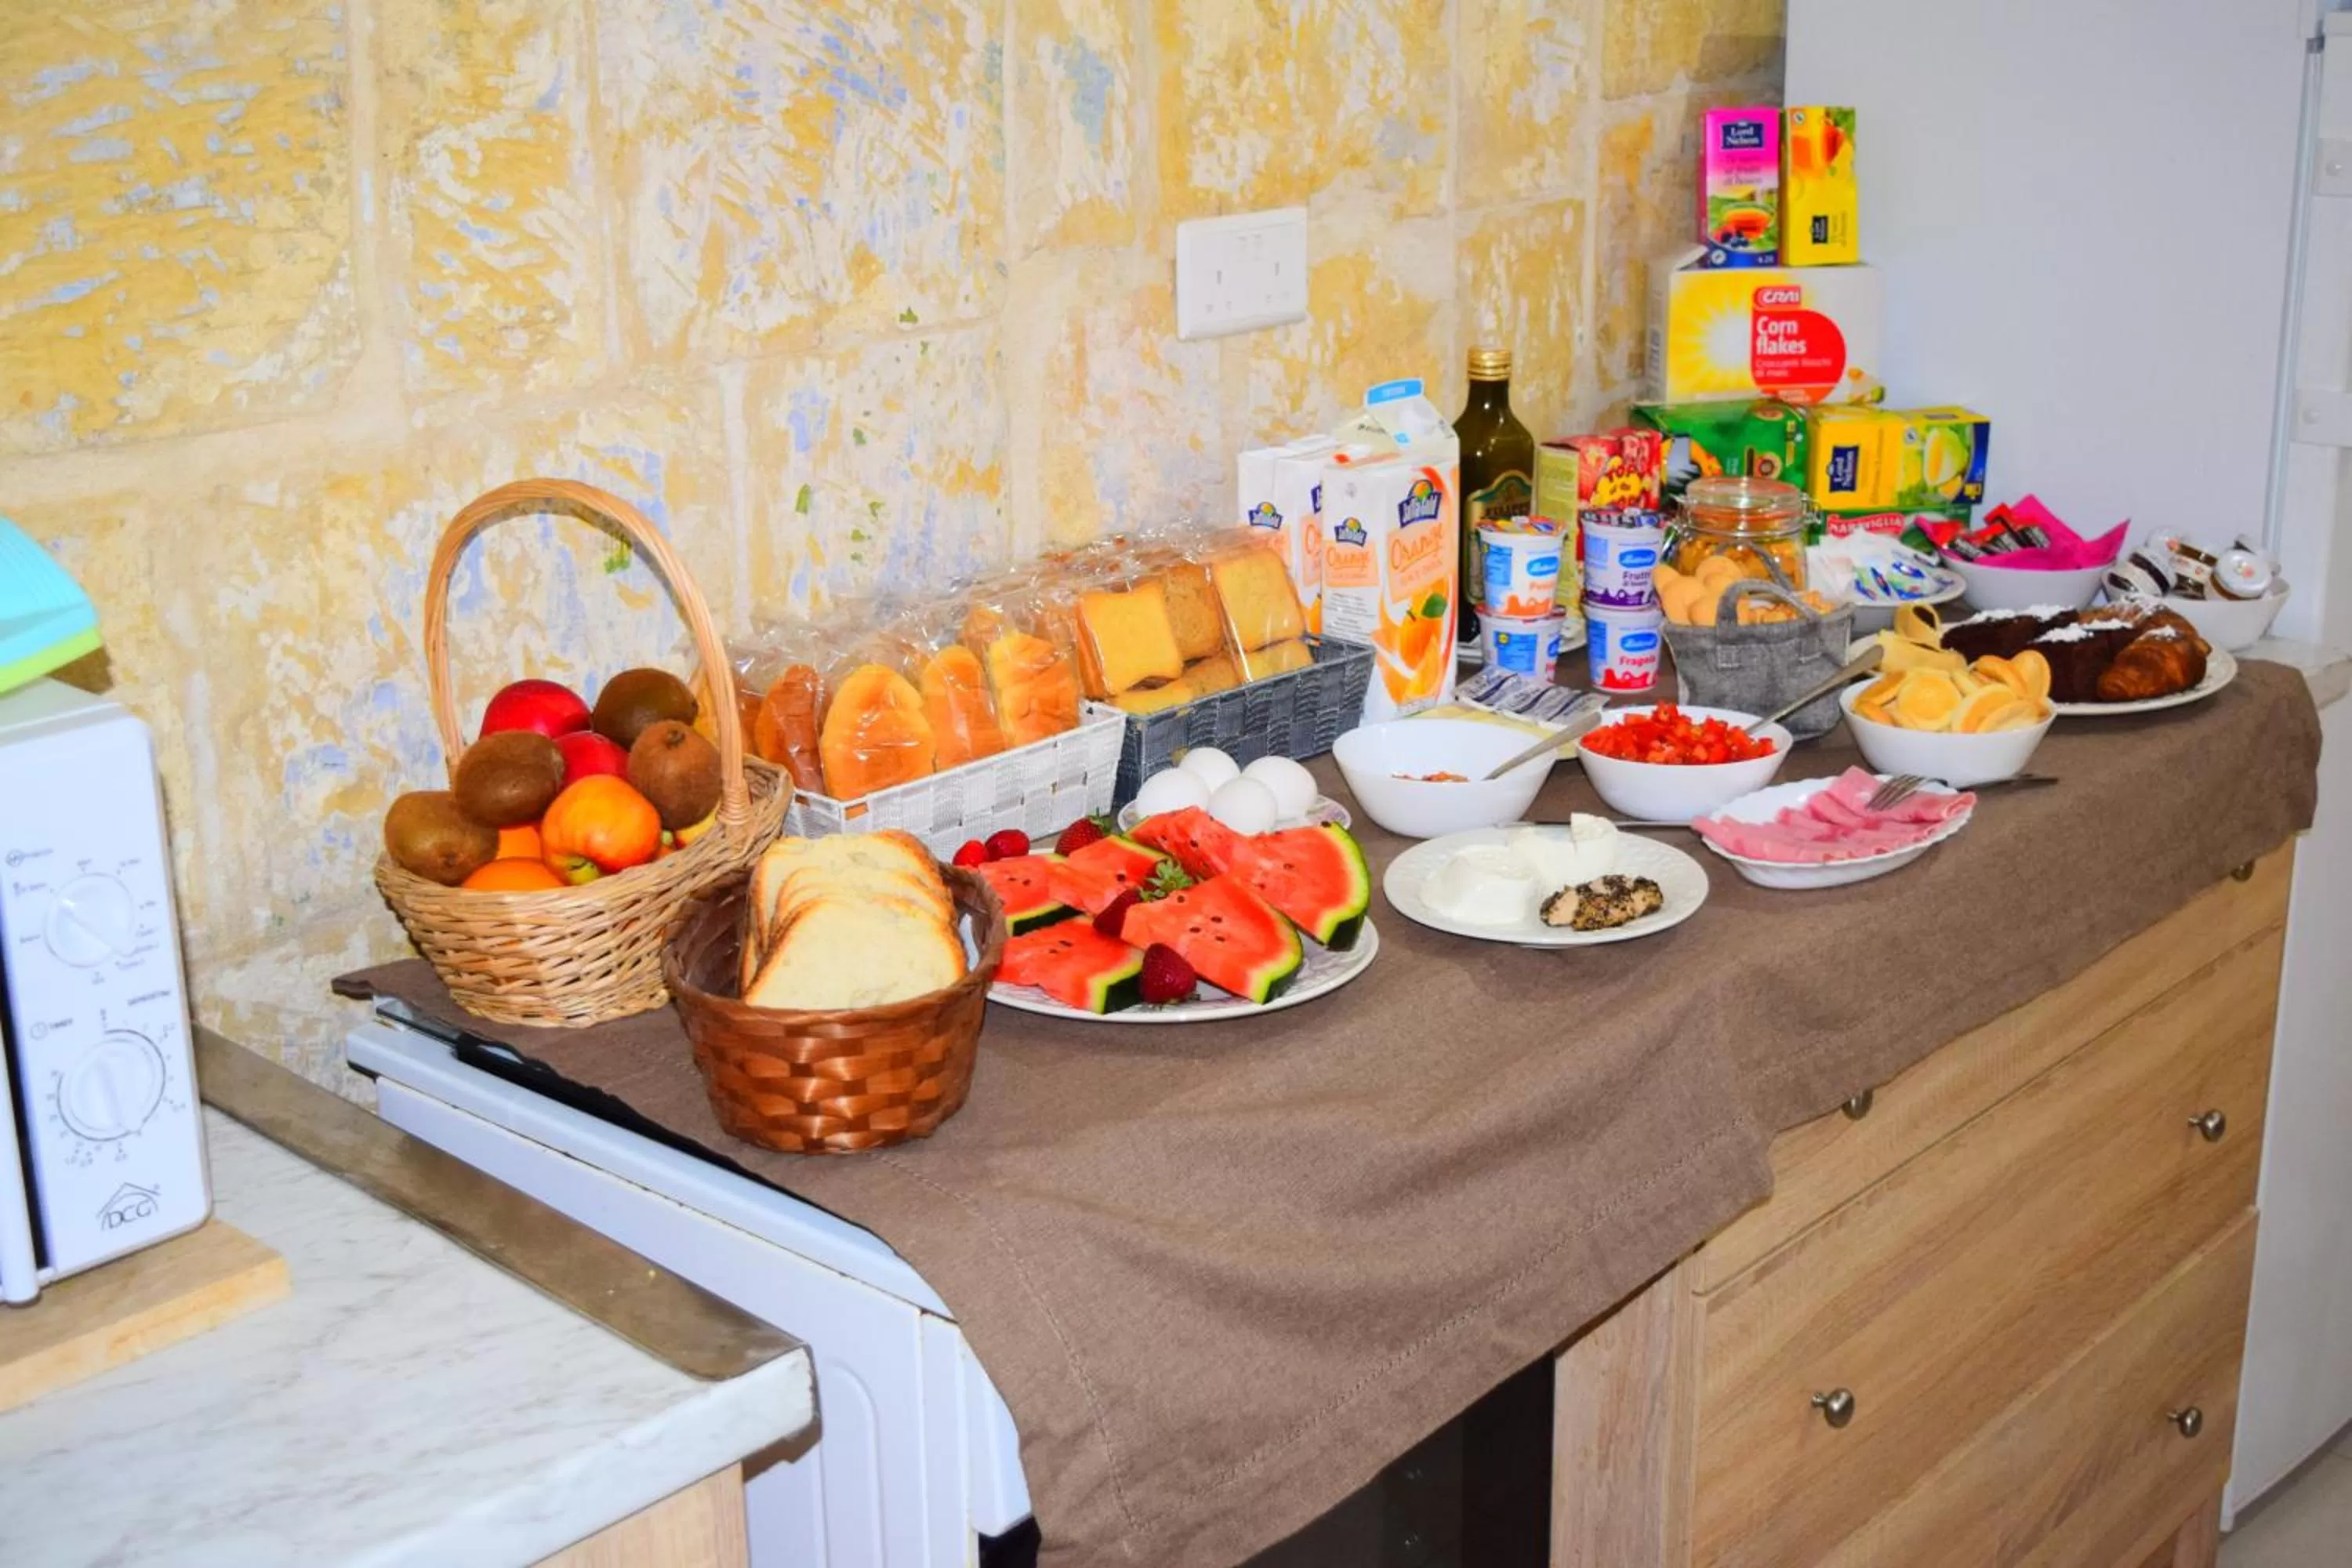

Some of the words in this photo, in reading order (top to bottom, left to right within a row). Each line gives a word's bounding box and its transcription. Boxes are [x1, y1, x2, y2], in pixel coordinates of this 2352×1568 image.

[1731, 126, 1754, 136] Lord
[1726, 135, 1759, 145] Nelson
[1756, 315, 1798, 335] Corn
[1755, 335, 1807, 355] flakes
